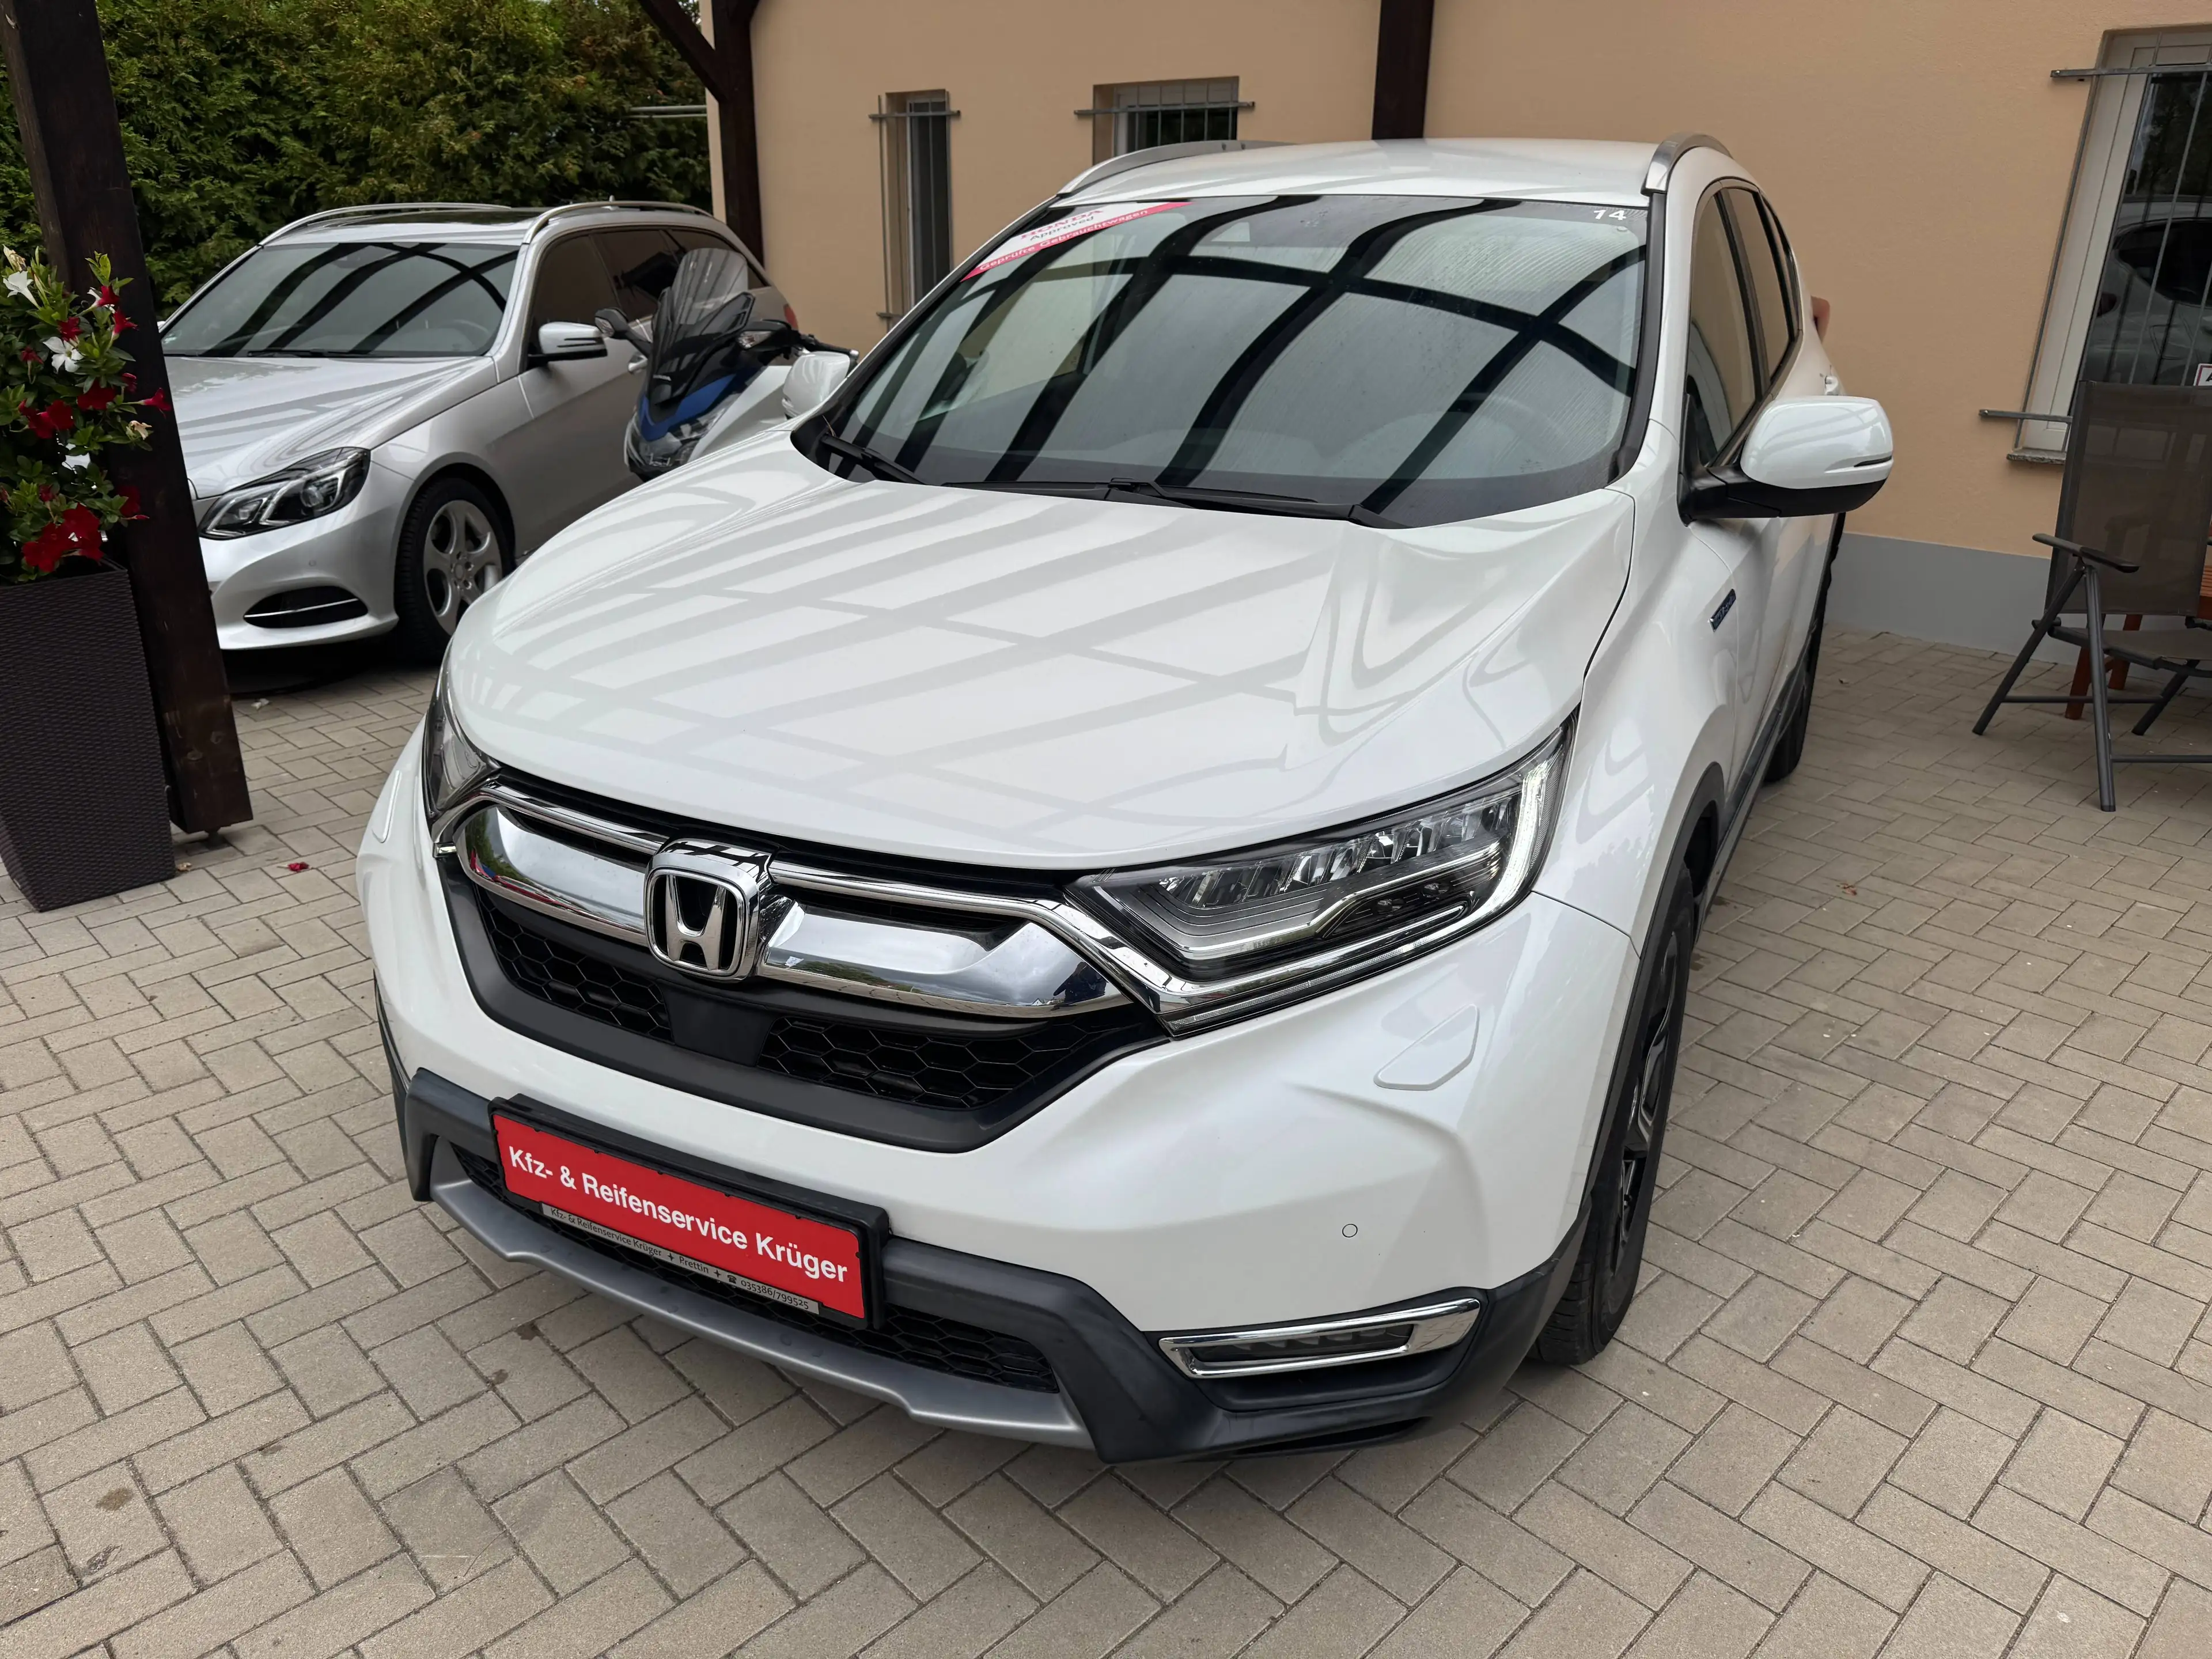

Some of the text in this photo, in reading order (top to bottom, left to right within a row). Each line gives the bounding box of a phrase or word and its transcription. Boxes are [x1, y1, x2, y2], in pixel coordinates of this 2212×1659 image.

[1020, 210, 1104, 240] HONDA
[1030, 216, 1094, 241] Approved
[1593, 210, 1626, 221] 14
[979, 210, 1148, 271] Geprüfte Gebrauchtwagen
[509, 1146, 848, 1282] Kfz- & Reifenservice Krüger
[550, 1207, 809, 1310] Kfz- & Reifenservice Krüger Prettin 035386/799525
